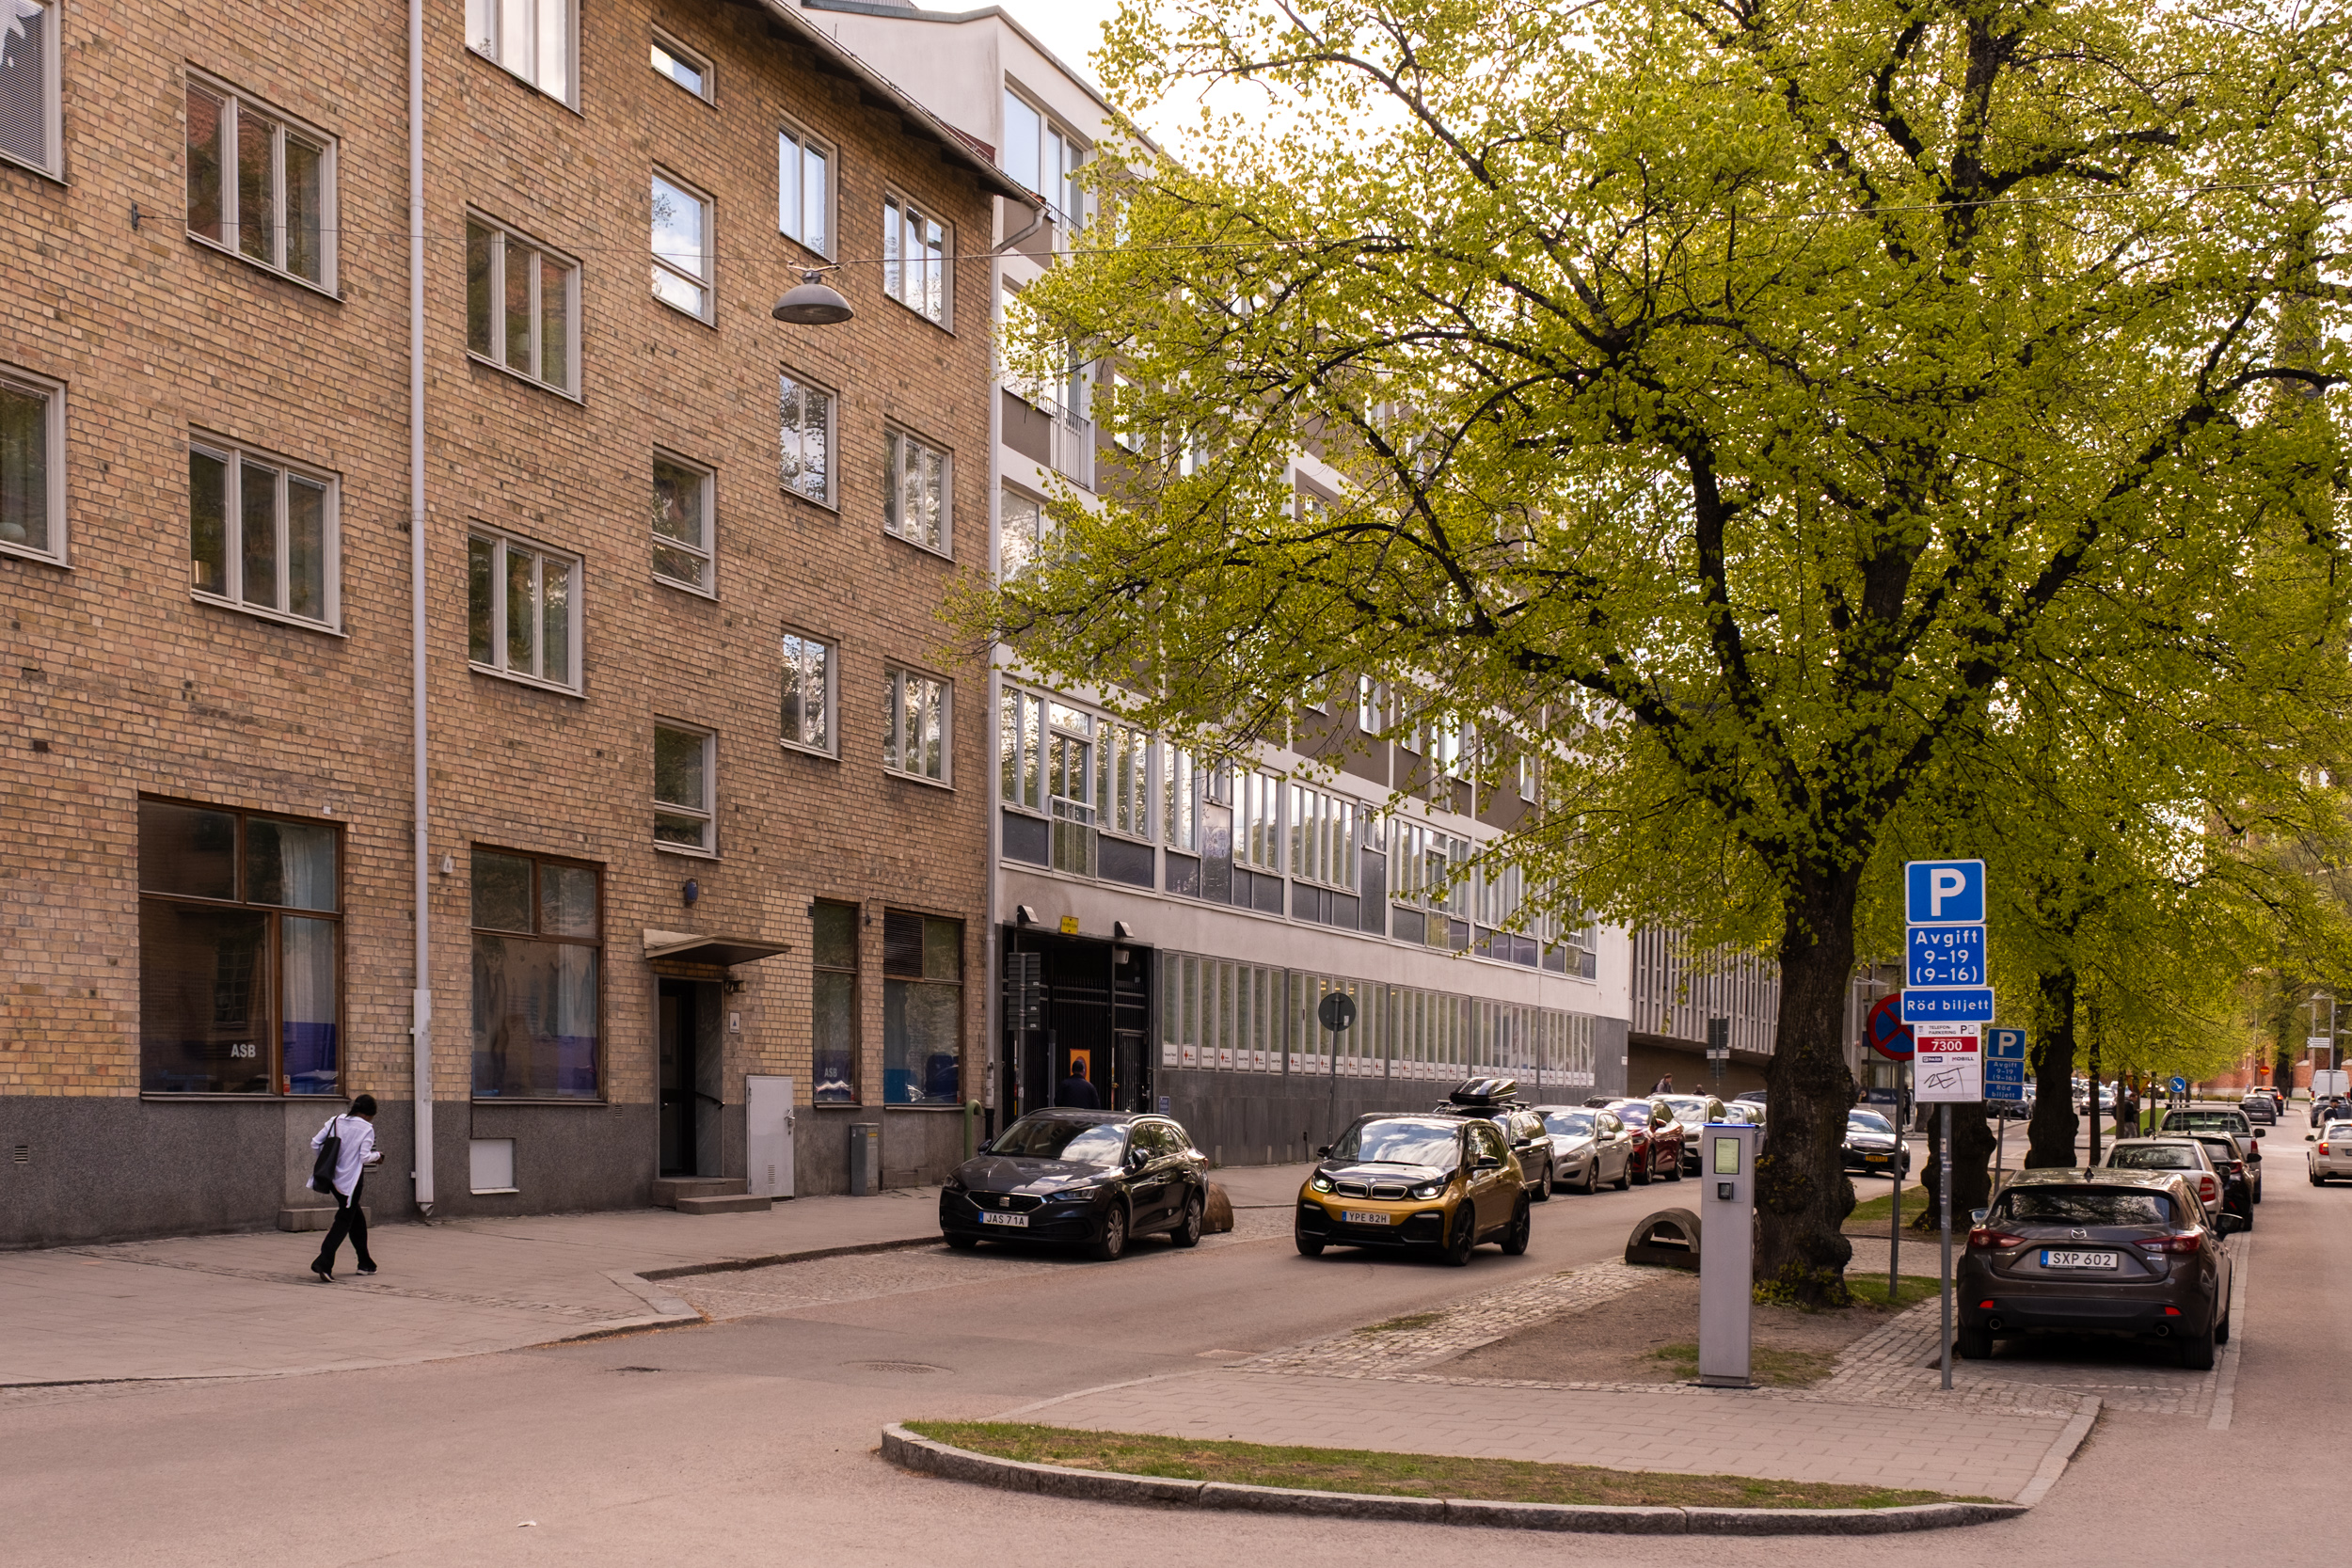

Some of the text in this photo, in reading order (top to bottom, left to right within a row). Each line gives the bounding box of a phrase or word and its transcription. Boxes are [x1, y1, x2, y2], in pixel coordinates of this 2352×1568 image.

[1931, 868, 1966, 916] P
[1915, 930, 1978, 947] Avgift
[1924, 950, 1969, 964] 9-19
[1915, 966, 1978, 982] (9-16)
[1907, 1000, 1989, 1013] Röd biljett
[1931, 1040, 1963, 1051] 7300
[1998, 1031, 2017, 1055] P
[230, 1043, 256, 1058] ASB
[824, 1068, 837, 1078] ASB
[987, 1214, 1024, 1226] JAS 71A
[1349, 1212, 1387, 1223] YPE 82H
[2053, 1252, 2111, 1266] SXP 602
